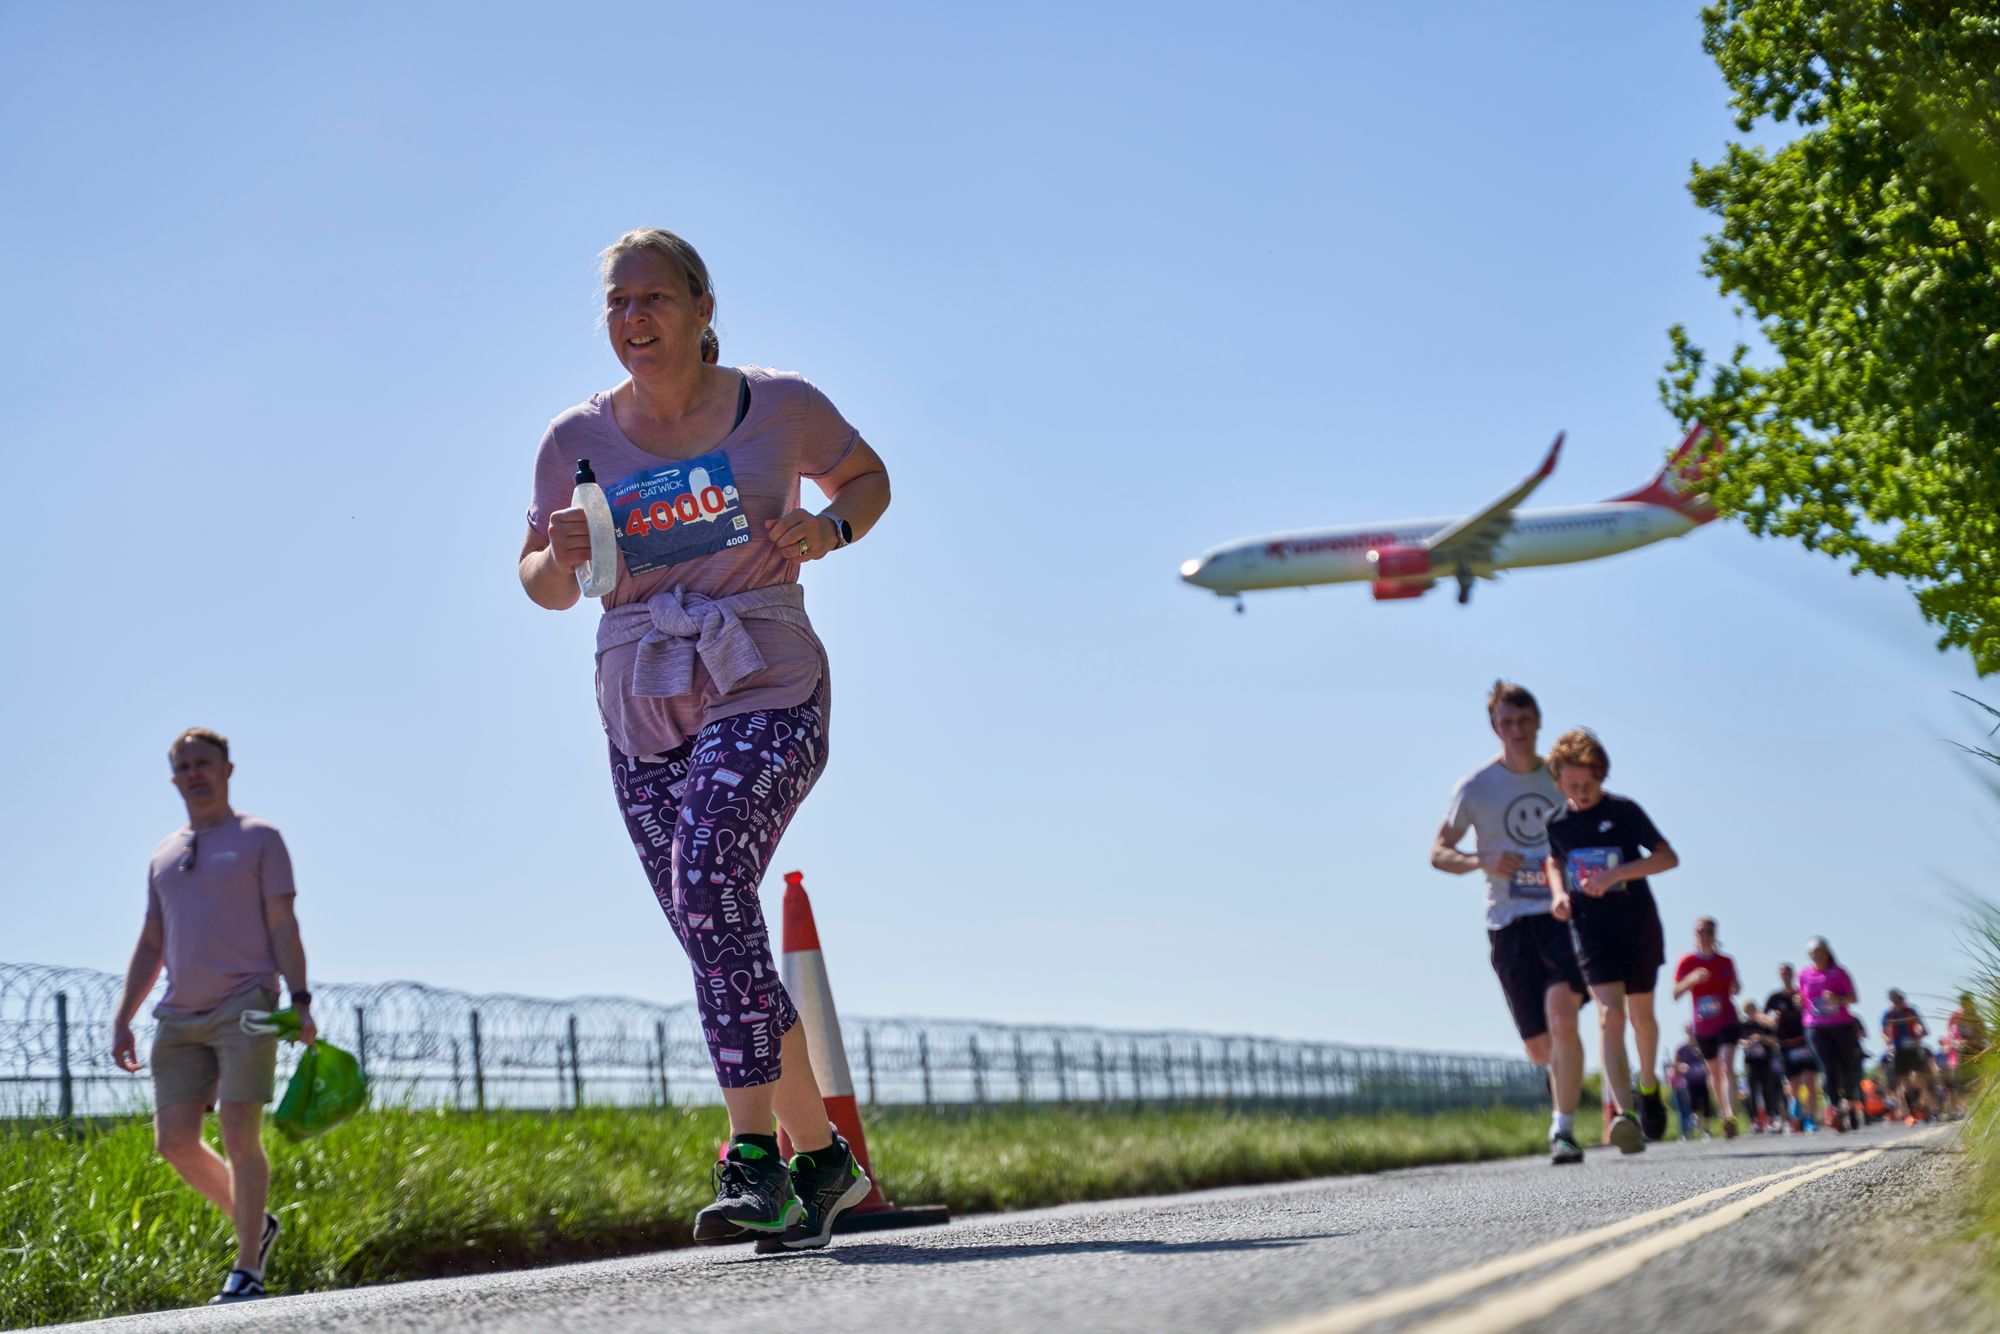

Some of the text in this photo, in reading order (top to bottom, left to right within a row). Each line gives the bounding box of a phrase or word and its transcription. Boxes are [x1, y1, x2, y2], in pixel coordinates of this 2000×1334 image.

[616, 476, 669, 497] BRITISH AIRWAYS
[639, 480, 685, 499] GATWICK
[626, 486, 725, 537] 4000
[726, 534, 749, 547] 4000
[698, 723, 722, 740] UN
[699, 750, 730, 765] 10K
[629, 766, 667, 785] marathon
[635, 783, 660, 802] 5K
[638, 812, 670, 848] RUN
[751, 815, 763, 827] app
[692, 816, 717, 848] 10K
[720, 887, 741, 924] RUN
[746, 939, 759, 948] app
[706, 966, 727, 997] 10K
[758, 992, 776, 1010] 5K
[704, 1028, 721, 1043] 0K
[752, 1022, 769, 1059] RUN
